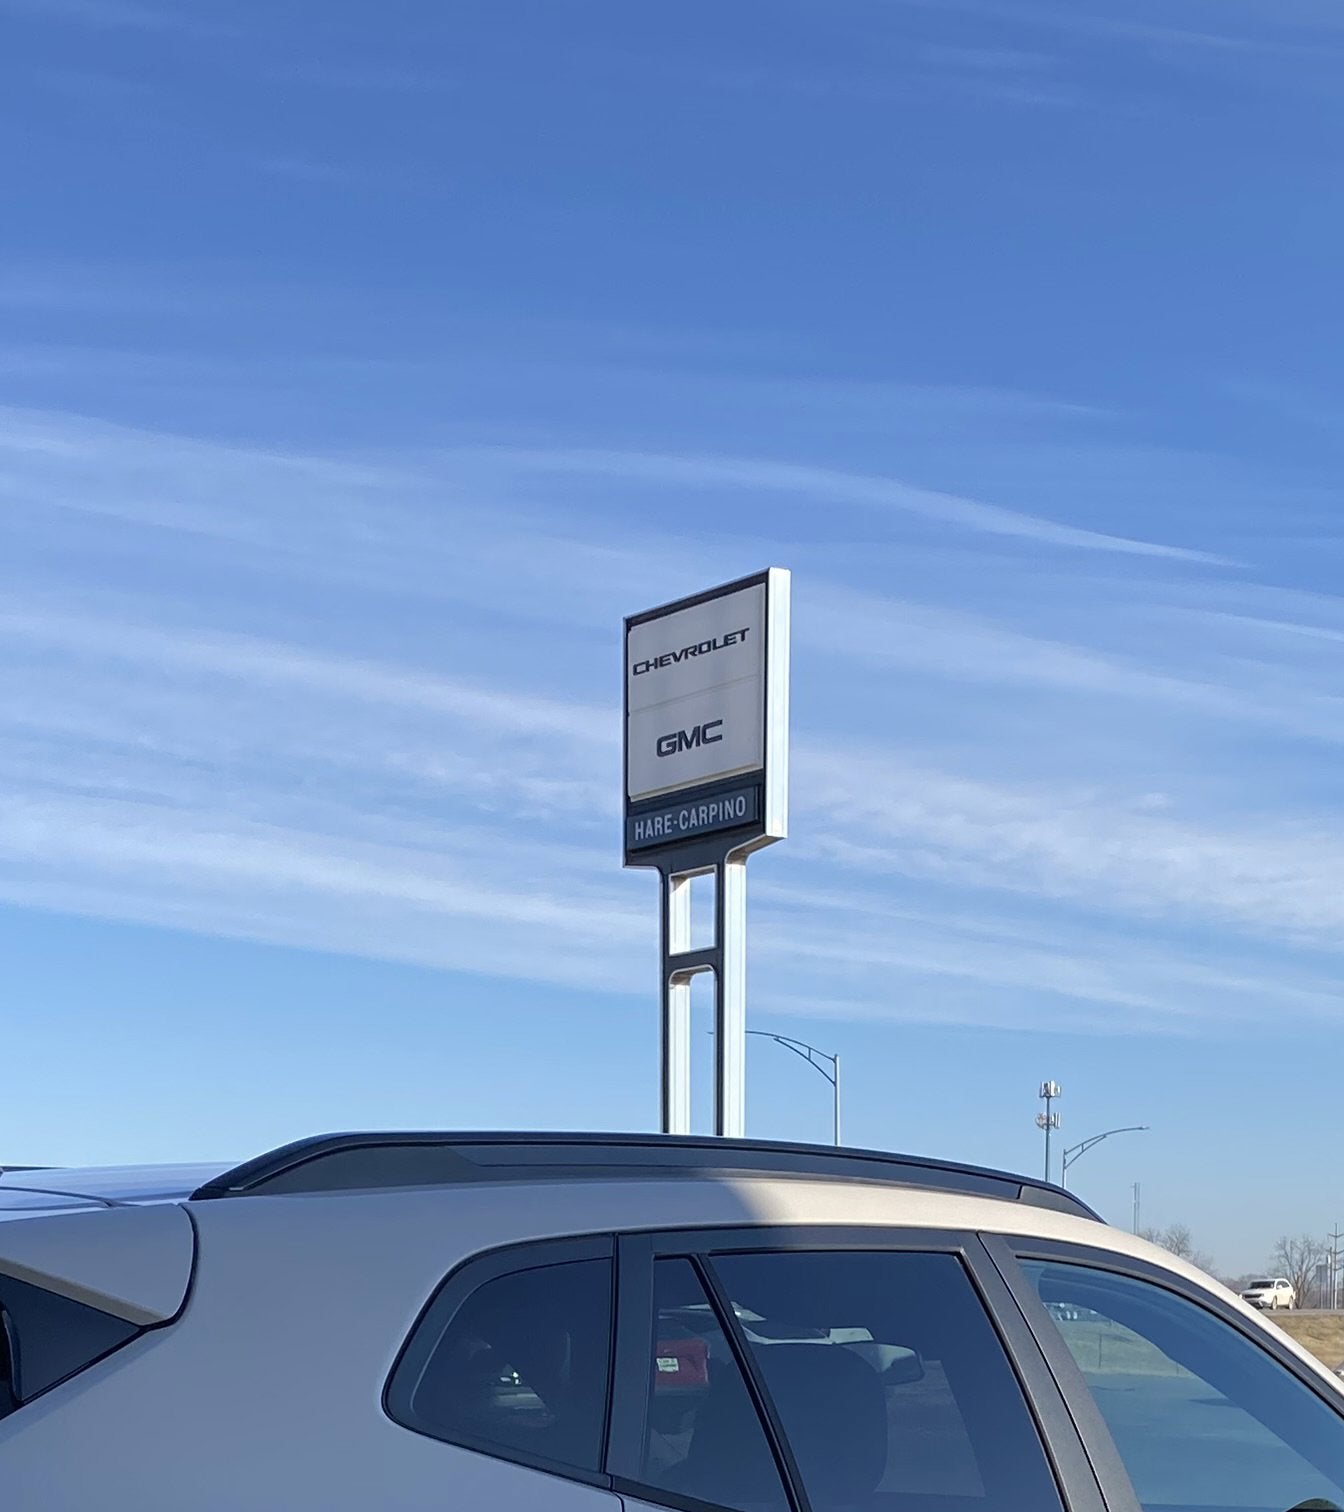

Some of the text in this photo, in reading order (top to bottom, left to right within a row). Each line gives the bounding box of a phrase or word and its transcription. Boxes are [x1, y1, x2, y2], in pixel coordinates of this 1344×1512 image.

[632, 627, 750, 676] CHEVROLET
[656, 719, 723, 757] GMC
[635, 796, 746, 840] HARE-CARPINO
